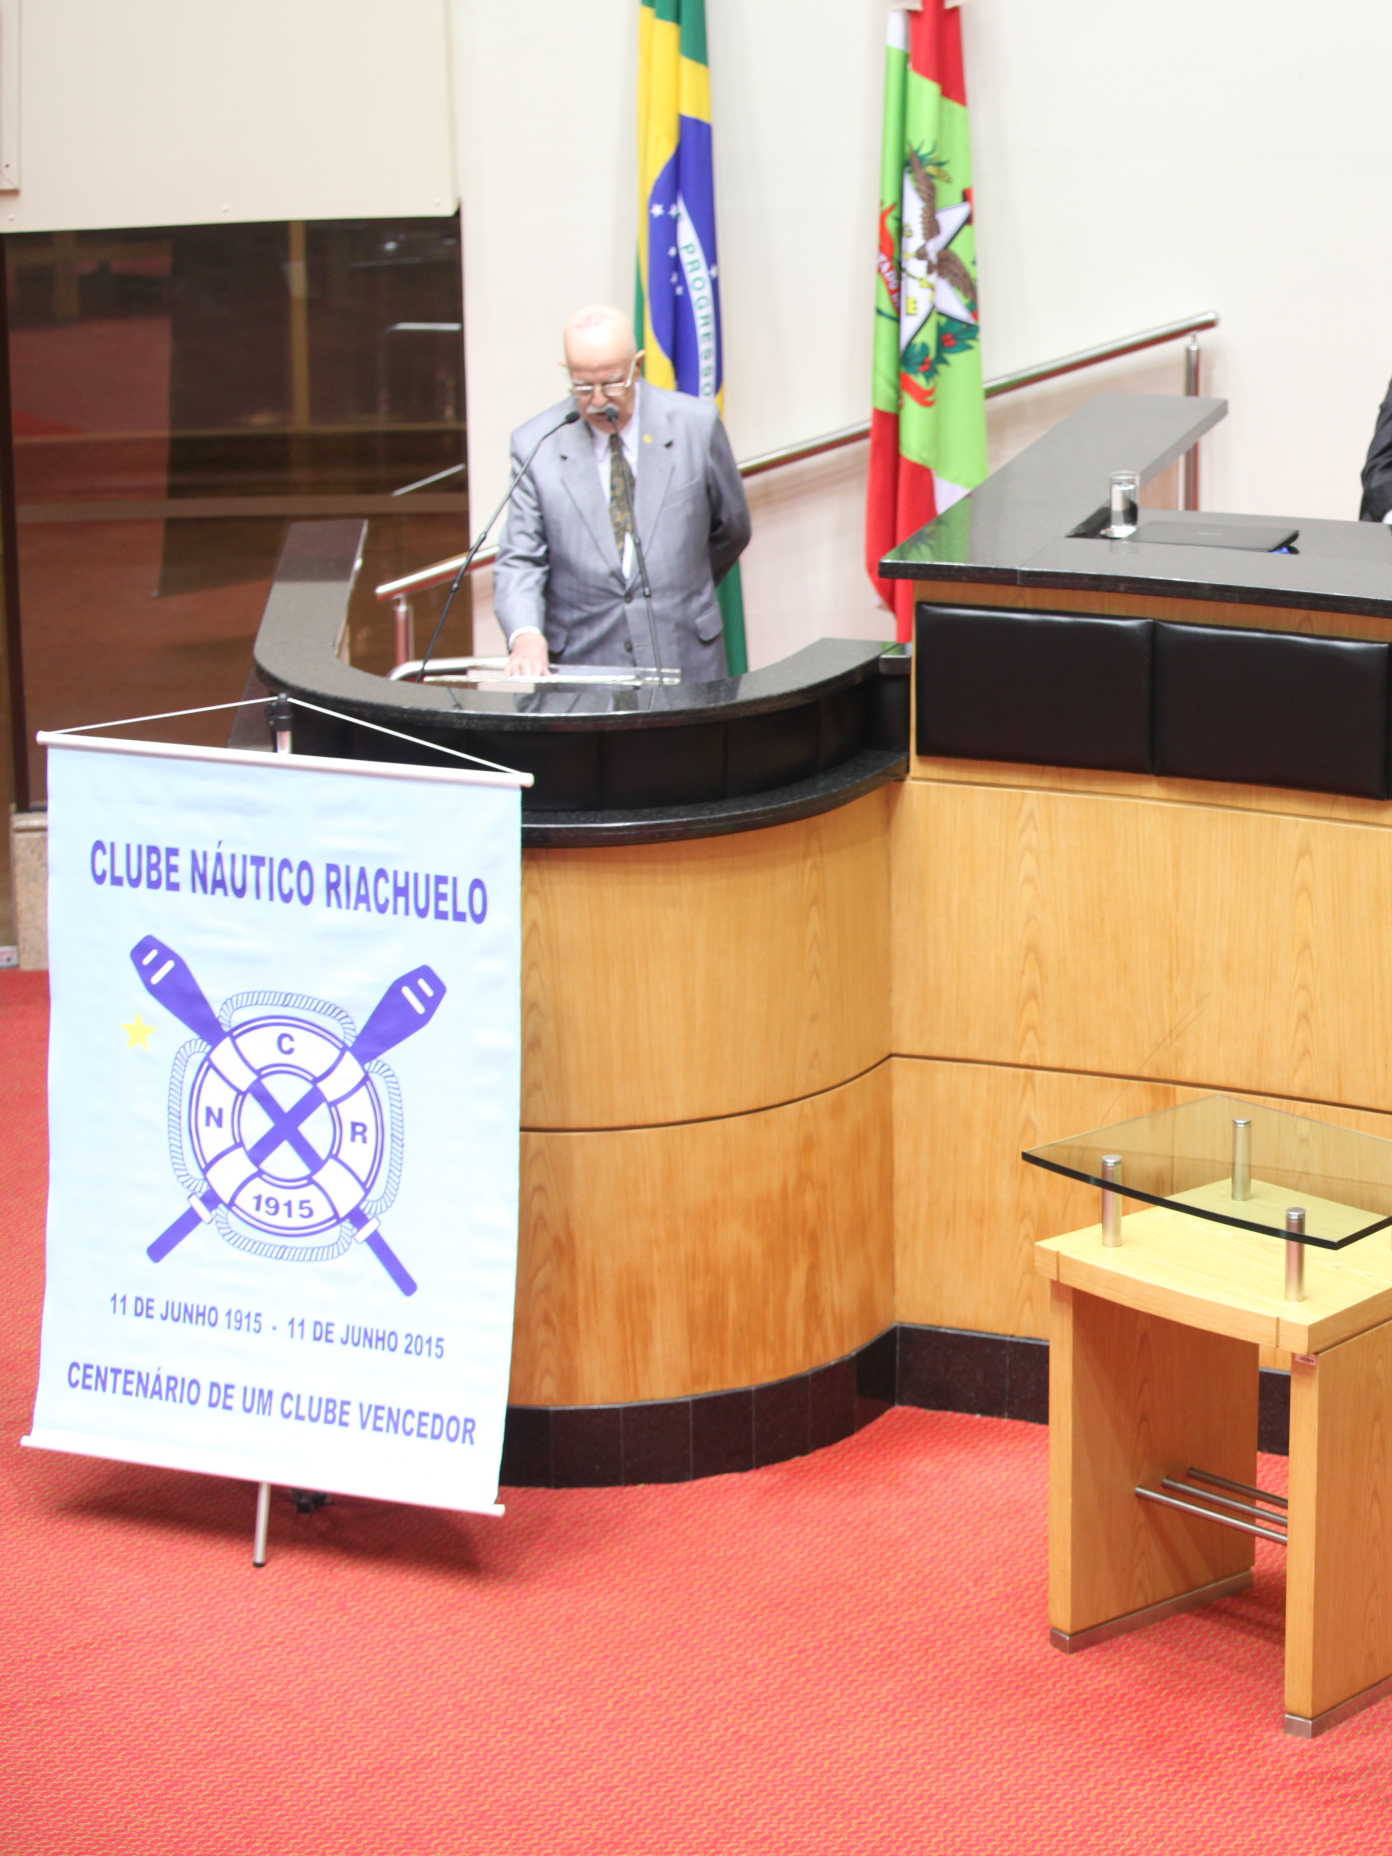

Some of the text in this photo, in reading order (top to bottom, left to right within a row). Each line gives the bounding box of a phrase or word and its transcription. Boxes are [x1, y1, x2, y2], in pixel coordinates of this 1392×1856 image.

[90, 839, 488, 925] CLUBE NÁUTICO RIACHUELO
[276, 1032, 295, 1056] C
[205, 1105, 224, 1129] N
[350, 1120, 368, 1145] R
[252, 1193, 315, 1219] 1915
[110, 1293, 128, 1316] 11
[134, 1296, 155, 1319] DE
[160, 1300, 219, 1328] JUNHO
[225, 1308, 262, 1334] 1915
[288, 1317, 306, 1340] 11
[312, 1320, 335, 1344] DE
[340, 1324, 399, 1353] JUNHO
[403, 1333, 444, 1359] 2015
[67, 1361, 476, 1445] CENTENÁRIO DE UM CLUBE VENCEDOR
